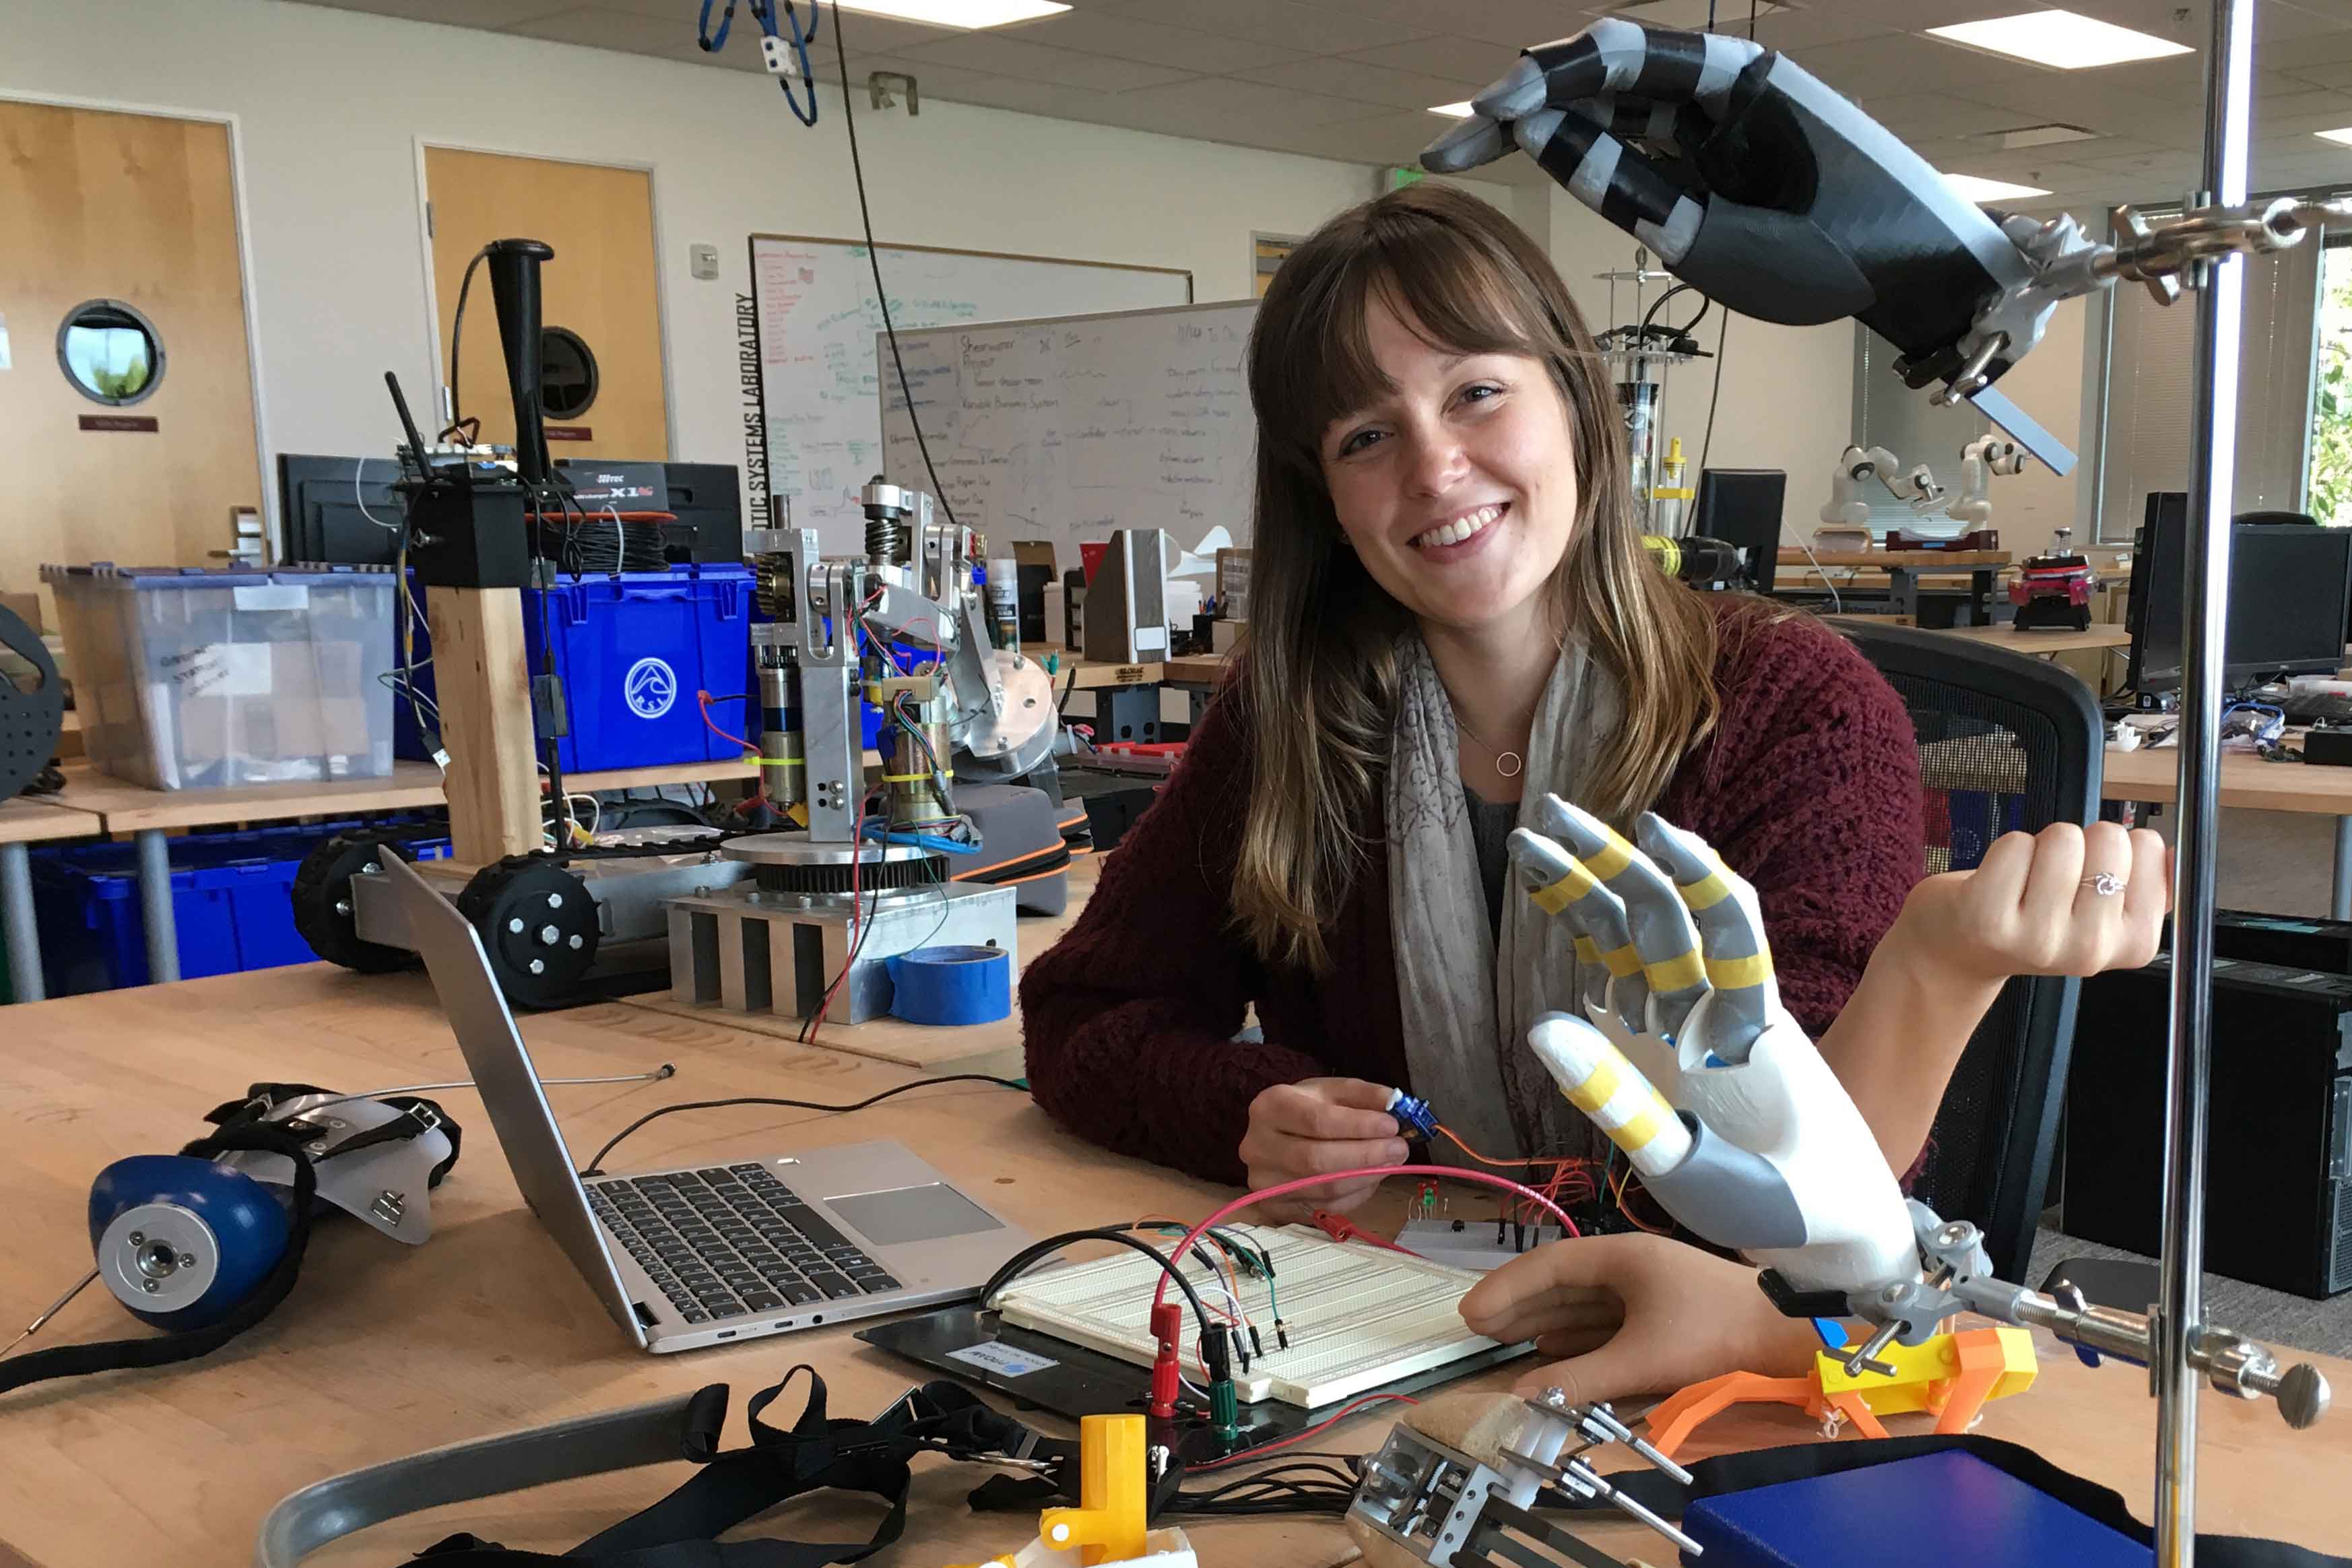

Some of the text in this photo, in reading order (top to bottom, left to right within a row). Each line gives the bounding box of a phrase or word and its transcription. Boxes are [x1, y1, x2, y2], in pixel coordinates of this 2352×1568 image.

[736, 293, 760, 406] LABORATORY
[744, 413, 765, 491] SYSTEMS
[635, 694, 667, 711] RSL
[1517, 1184, 1546, 1204] MODEL
